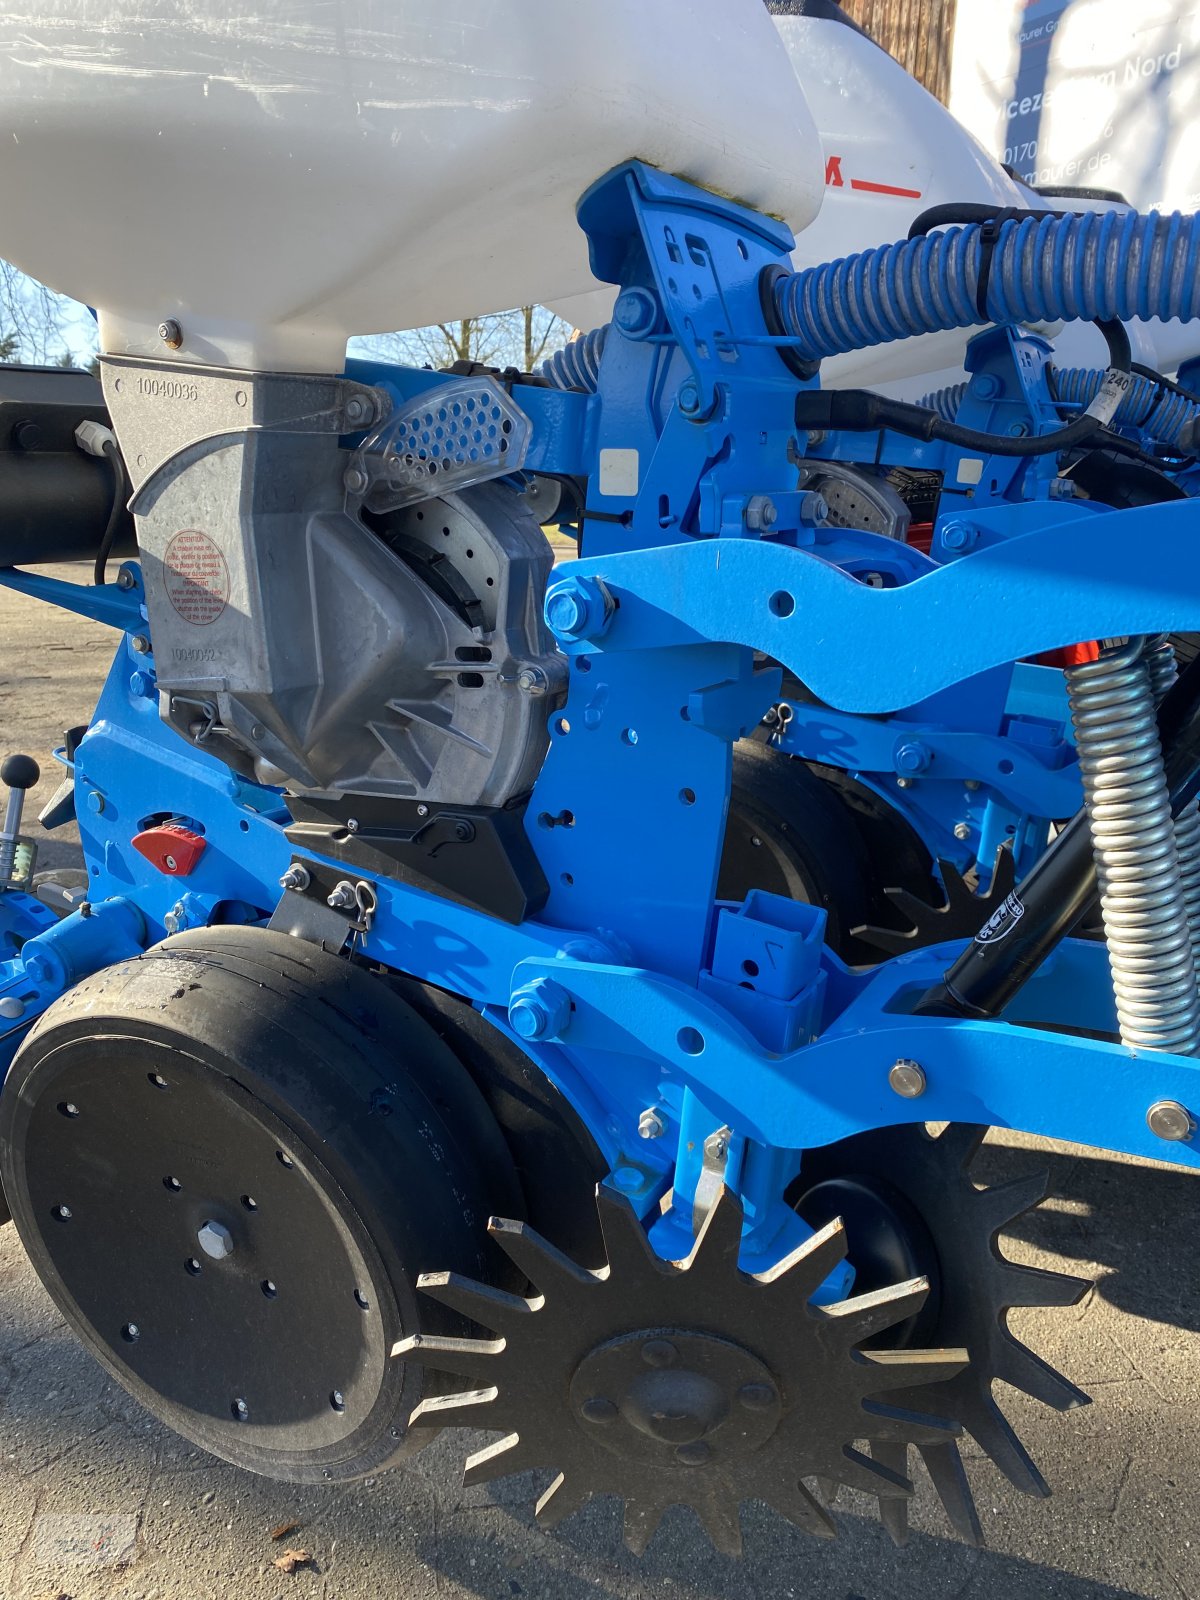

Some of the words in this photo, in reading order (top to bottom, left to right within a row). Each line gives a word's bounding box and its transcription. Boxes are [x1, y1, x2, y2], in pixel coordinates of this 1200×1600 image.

[1018, 26, 1044, 43] aurer
[1123, 43, 1182, 87] Nord
[1003, 140, 1038, 165] 0170
[1020, 151, 1112, 187] maurer.de
[136, 377, 198, 402] 10040036
[1107, 373, 1129, 391] 240
